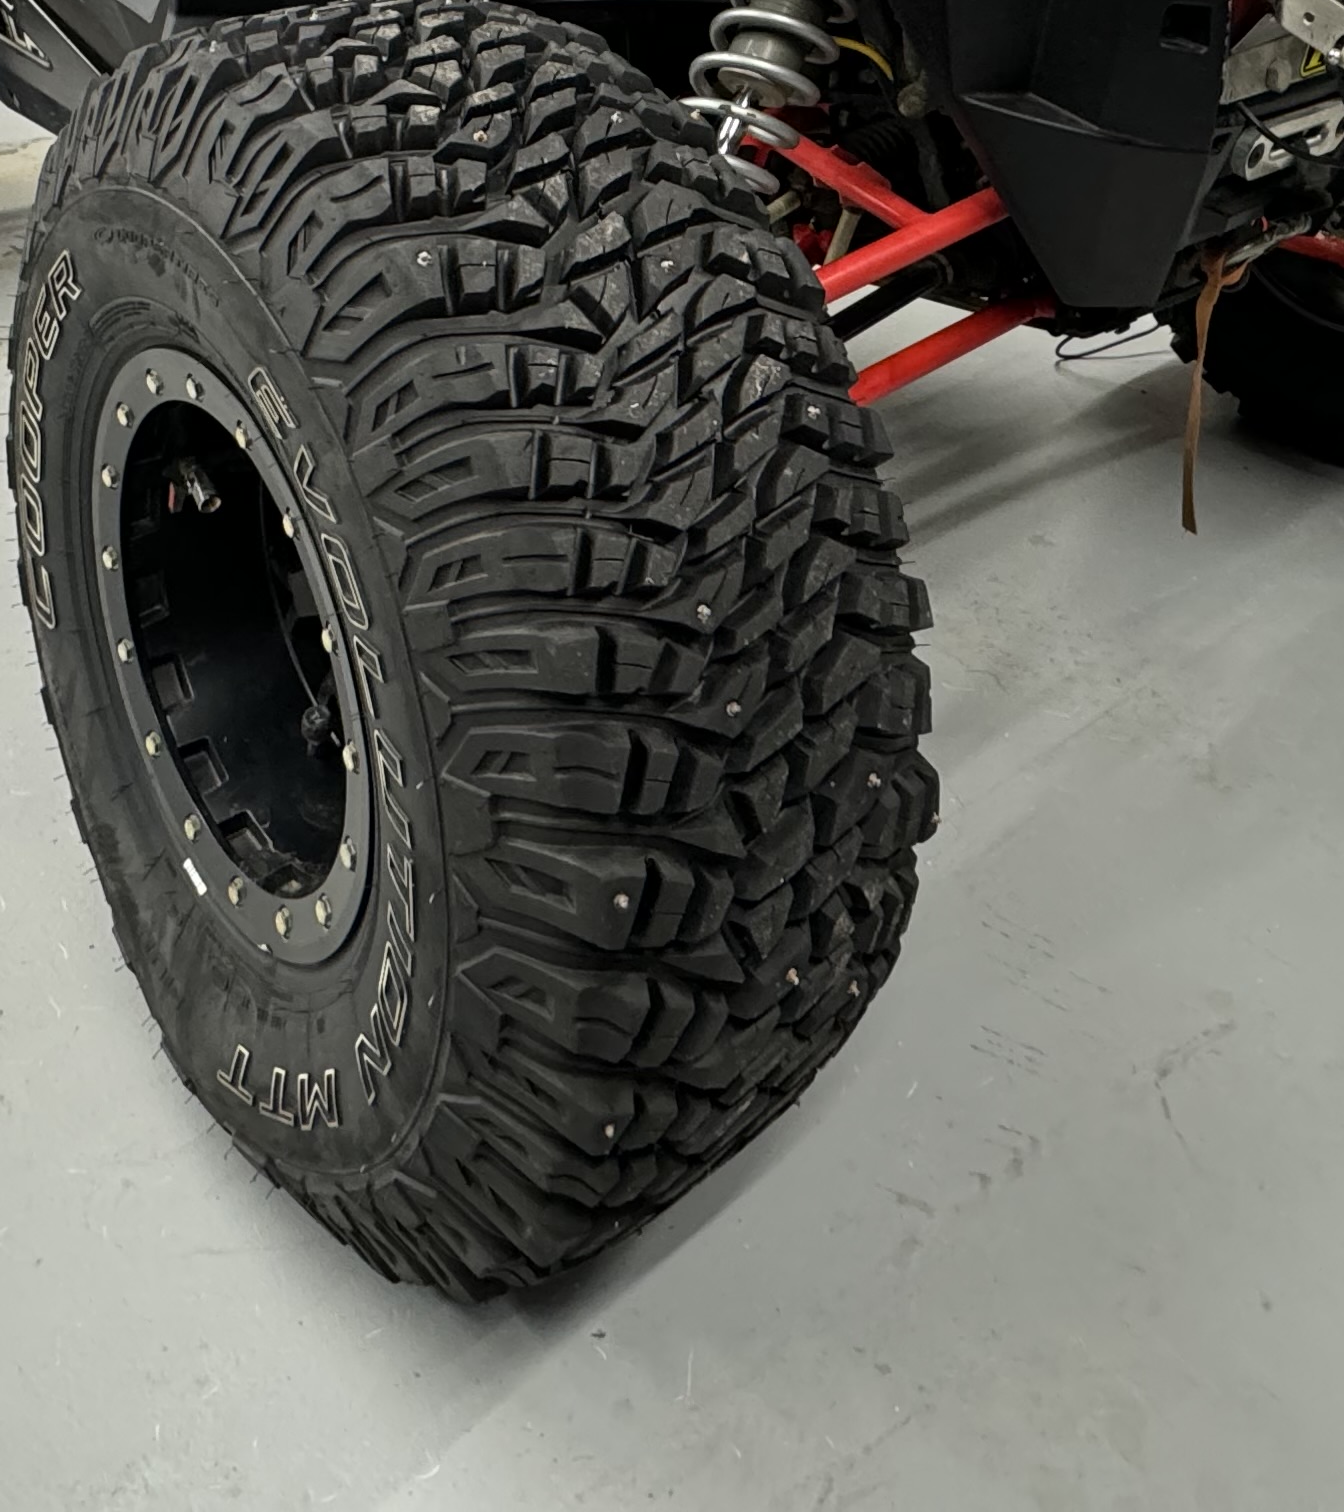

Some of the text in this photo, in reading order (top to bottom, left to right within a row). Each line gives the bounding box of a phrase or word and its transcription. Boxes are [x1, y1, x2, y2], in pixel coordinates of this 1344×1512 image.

[20, 248, 83, 630] COOPER
[246, 364, 416, 1105] EVOLUTION
[216, 1044, 339, 1131] MTT
